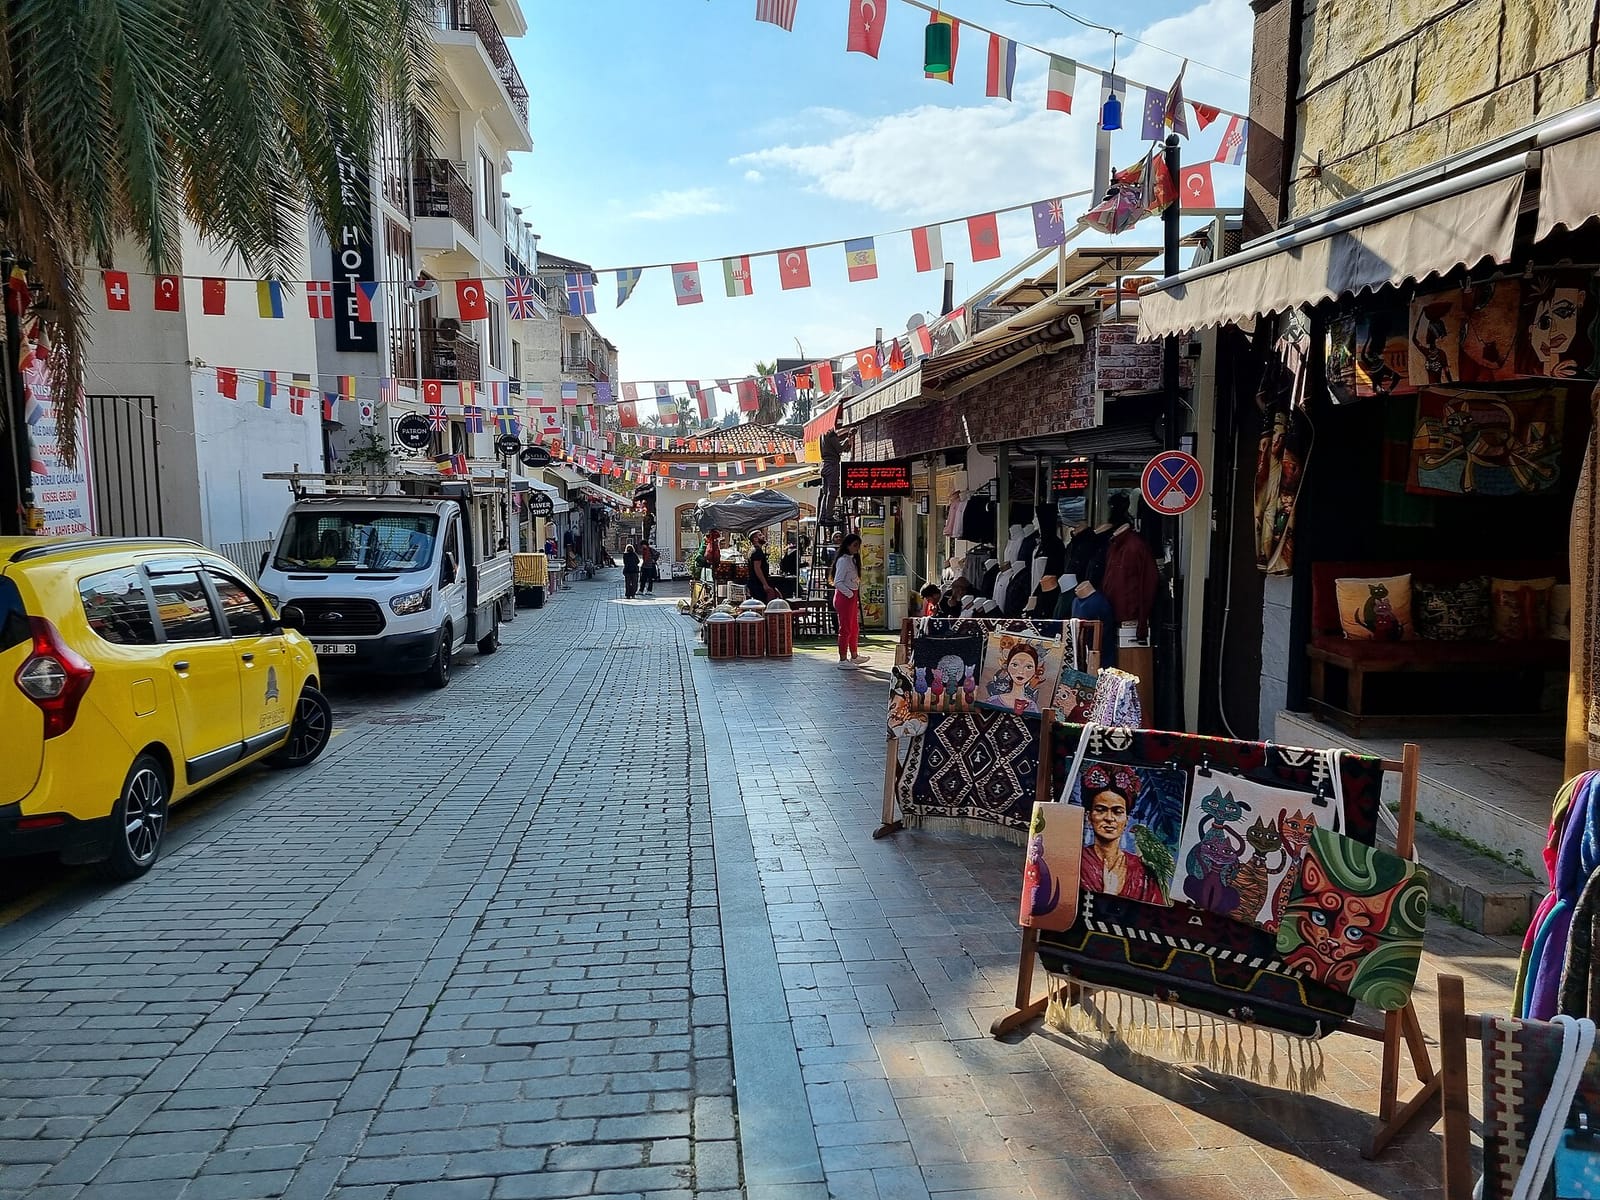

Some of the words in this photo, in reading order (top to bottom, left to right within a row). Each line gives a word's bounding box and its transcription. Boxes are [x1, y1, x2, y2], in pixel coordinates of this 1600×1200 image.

[341, 225, 363, 340] HOTEL
[870, 589, 885, 597] FUS
[322, 645, 337, 653] BFU
[345, 645, 354, 653] 39
